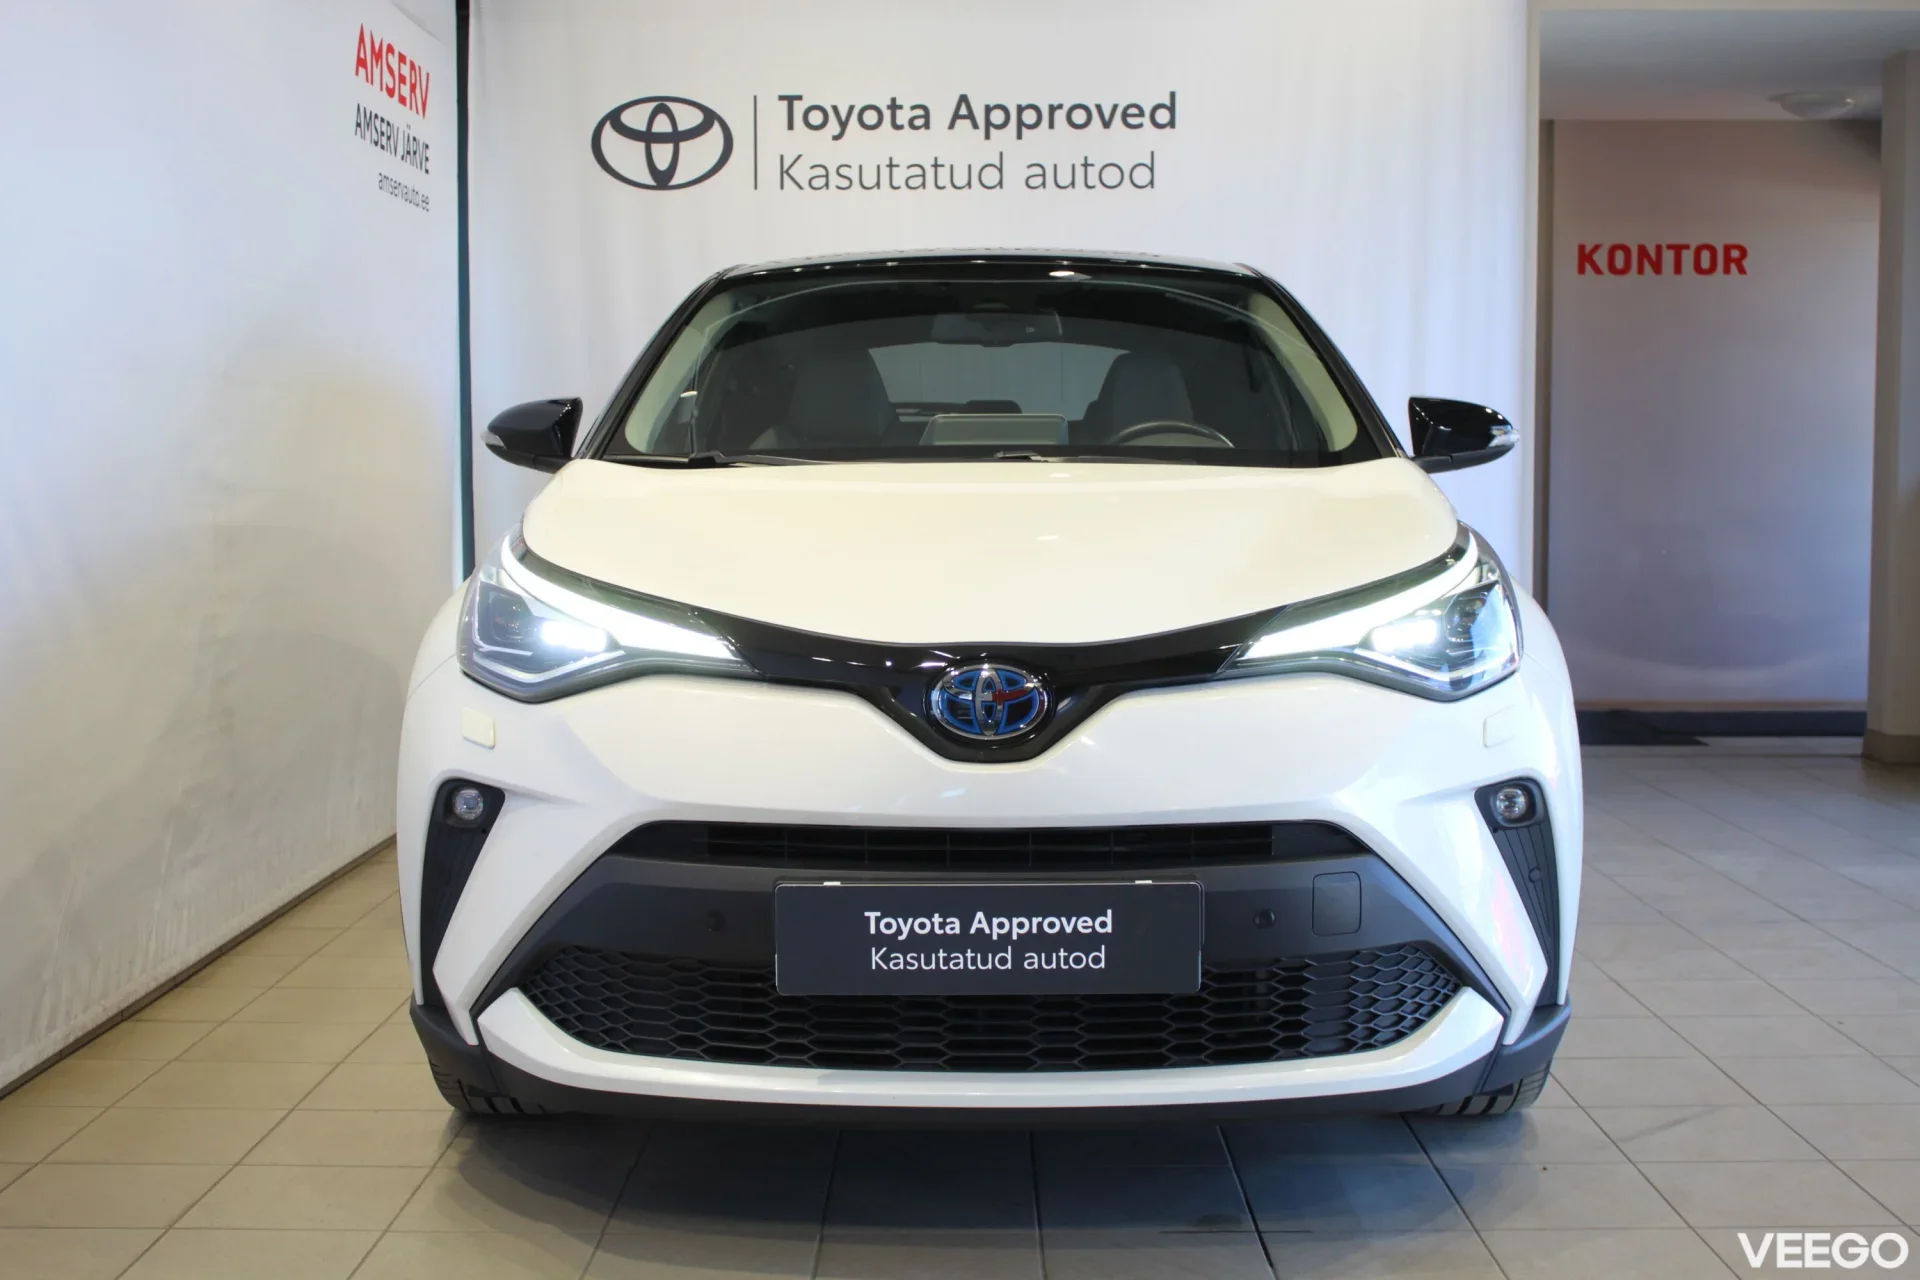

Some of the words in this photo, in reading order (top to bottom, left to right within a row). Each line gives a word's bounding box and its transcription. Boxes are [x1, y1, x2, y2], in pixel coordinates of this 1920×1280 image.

[355, 22, 430, 119] AMSERV
[778, 94, 931, 141] Toyota
[947, 90, 1177, 141] Approved
[354, 102, 399, 158] AMSERV
[401, 123, 430, 175] JÄRVE
[779, 151, 1004, 190] Kasutatud
[1024, 150, 1156, 190] autod
[378, 172, 430, 213] amservauto.ee
[1577, 243, 1748, 276] KONTOR
[864, 911, 961, 941] Toyota
[969, 909, 1113, 941] Approved
[871, 945, 1012, 970] Kasutatud
[1023, 945, 1106, 970] autod
